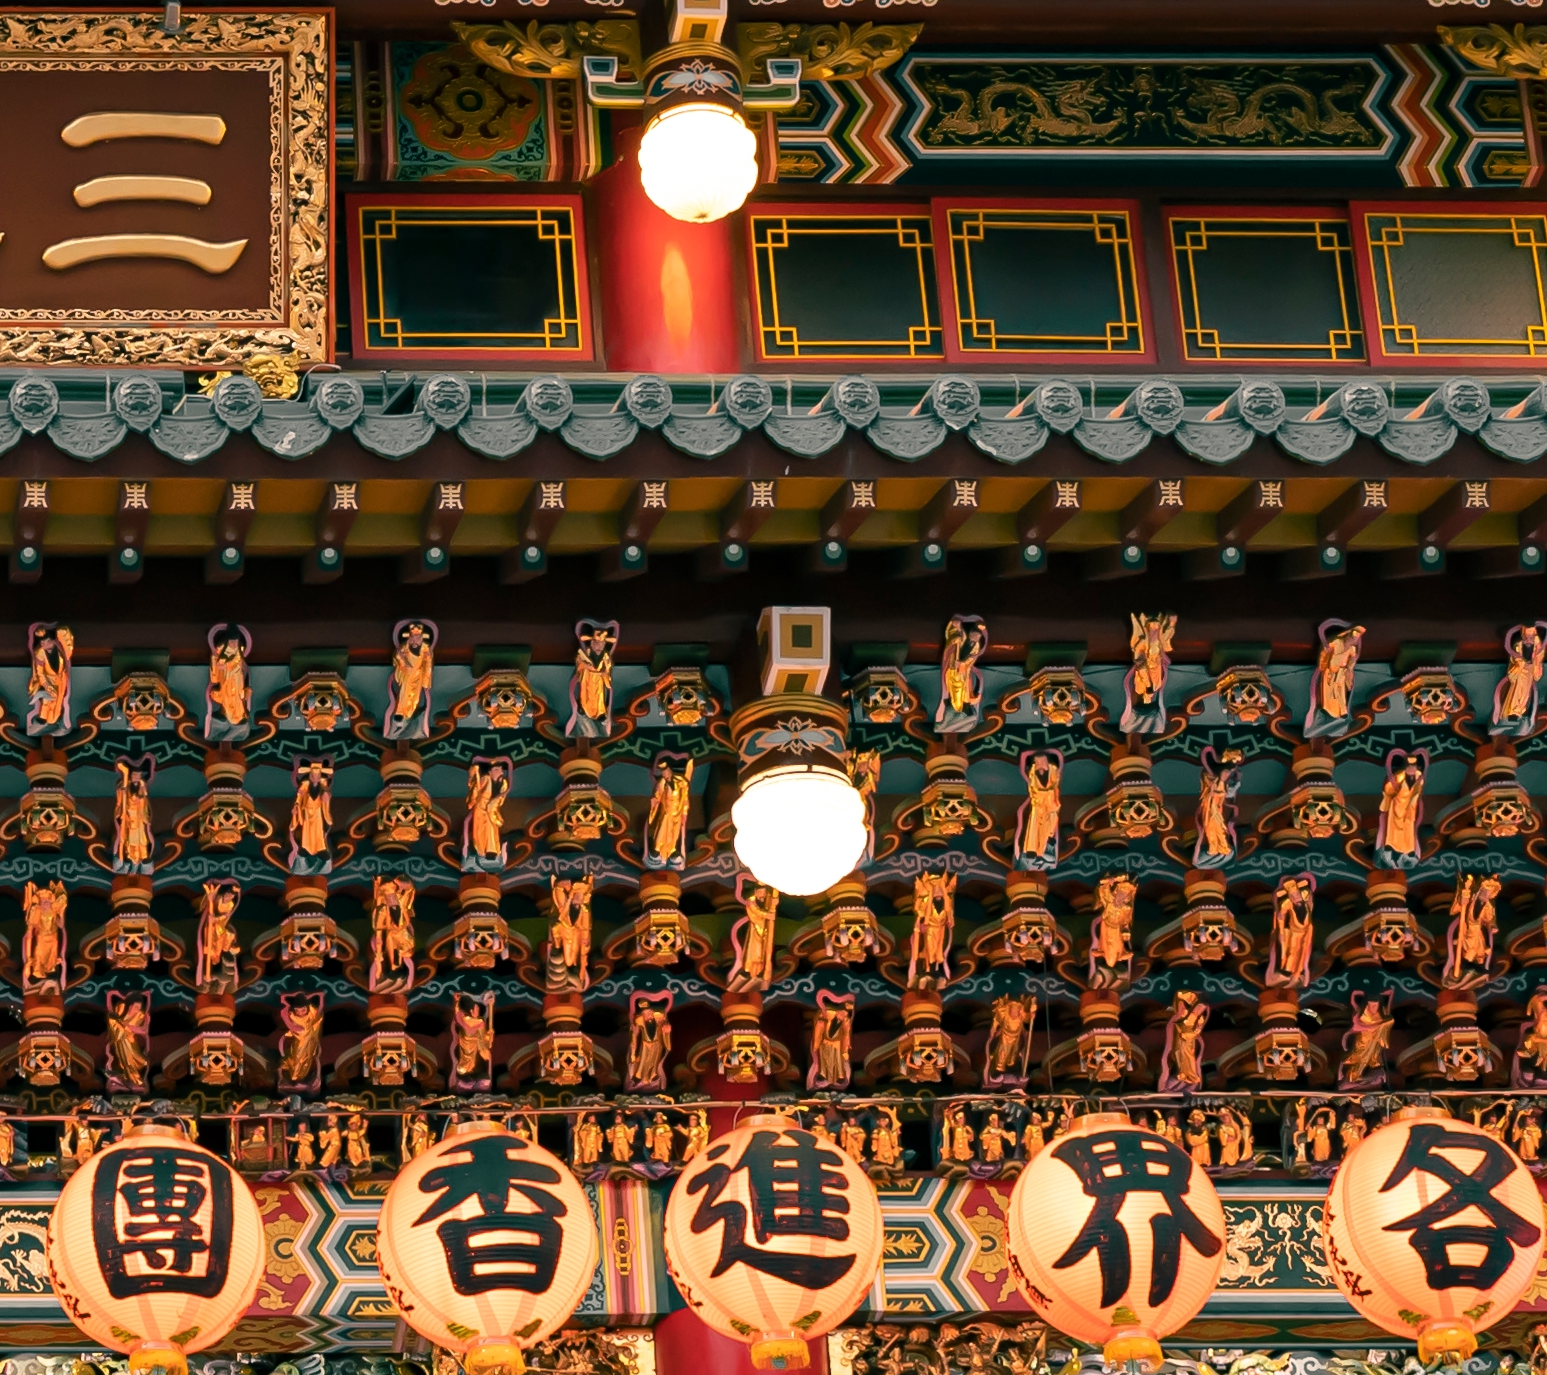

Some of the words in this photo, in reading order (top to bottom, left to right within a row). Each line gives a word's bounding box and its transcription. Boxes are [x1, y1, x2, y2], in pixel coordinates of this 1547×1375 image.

[91, 1145, 235, 1301] 團
[410, 1135, 569, 1297] 香
[685, 1129, 858, 1290] 進
[1049, 1129, 1223, 1309] 界
[1378, 1124, 1543, 1292] 各
